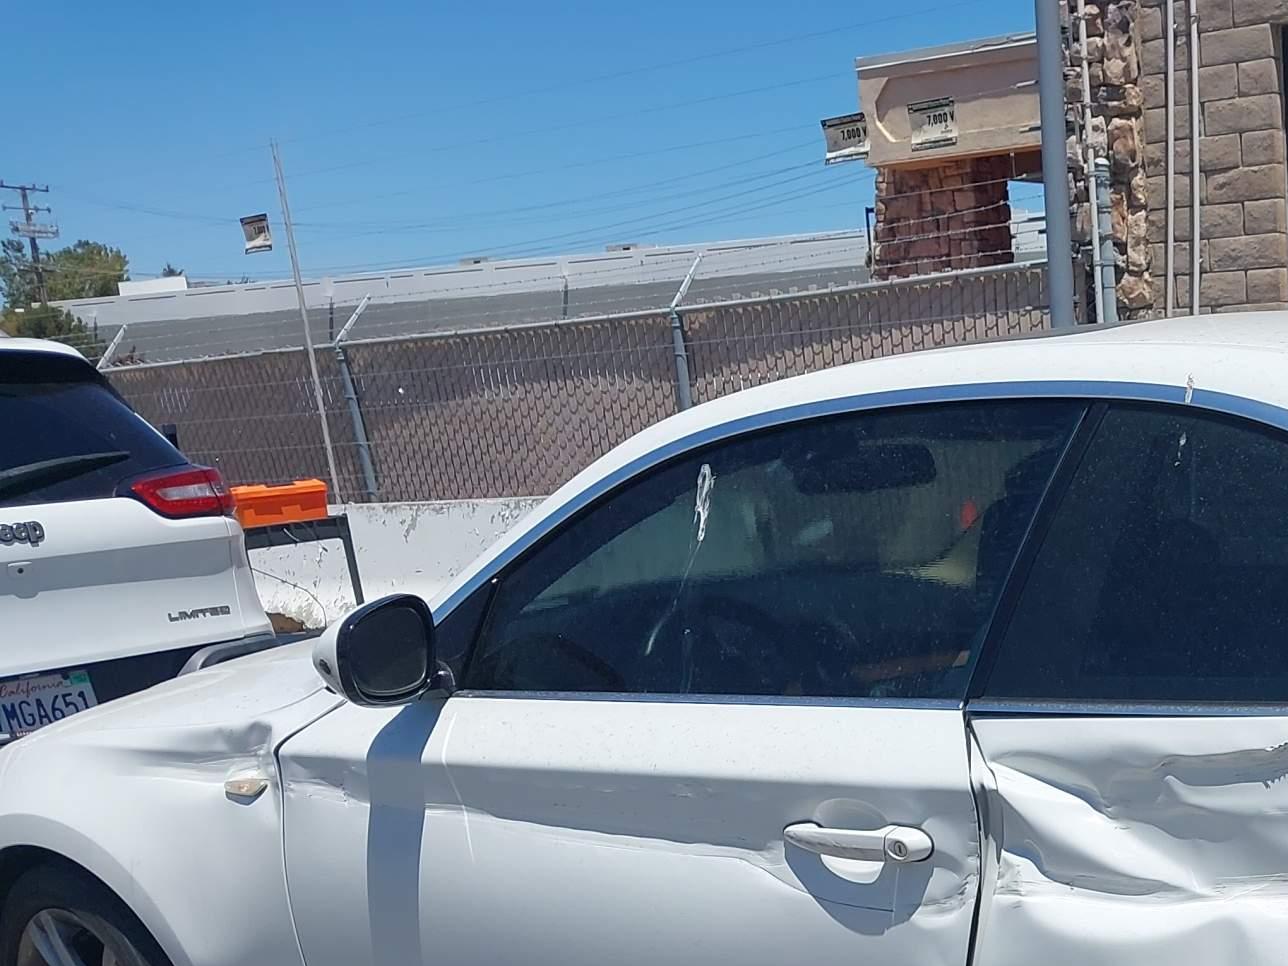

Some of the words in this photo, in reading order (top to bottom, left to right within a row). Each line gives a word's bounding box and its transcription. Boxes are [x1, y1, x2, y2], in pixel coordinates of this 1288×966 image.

[926, 111, 948, 127] 7,000
[840, 127, 861, 141] 7,000
[168, 605, 231, 622] LIMITED
[0, 681, 63, 698] California
[0, 691, 89, 733] MGA651
